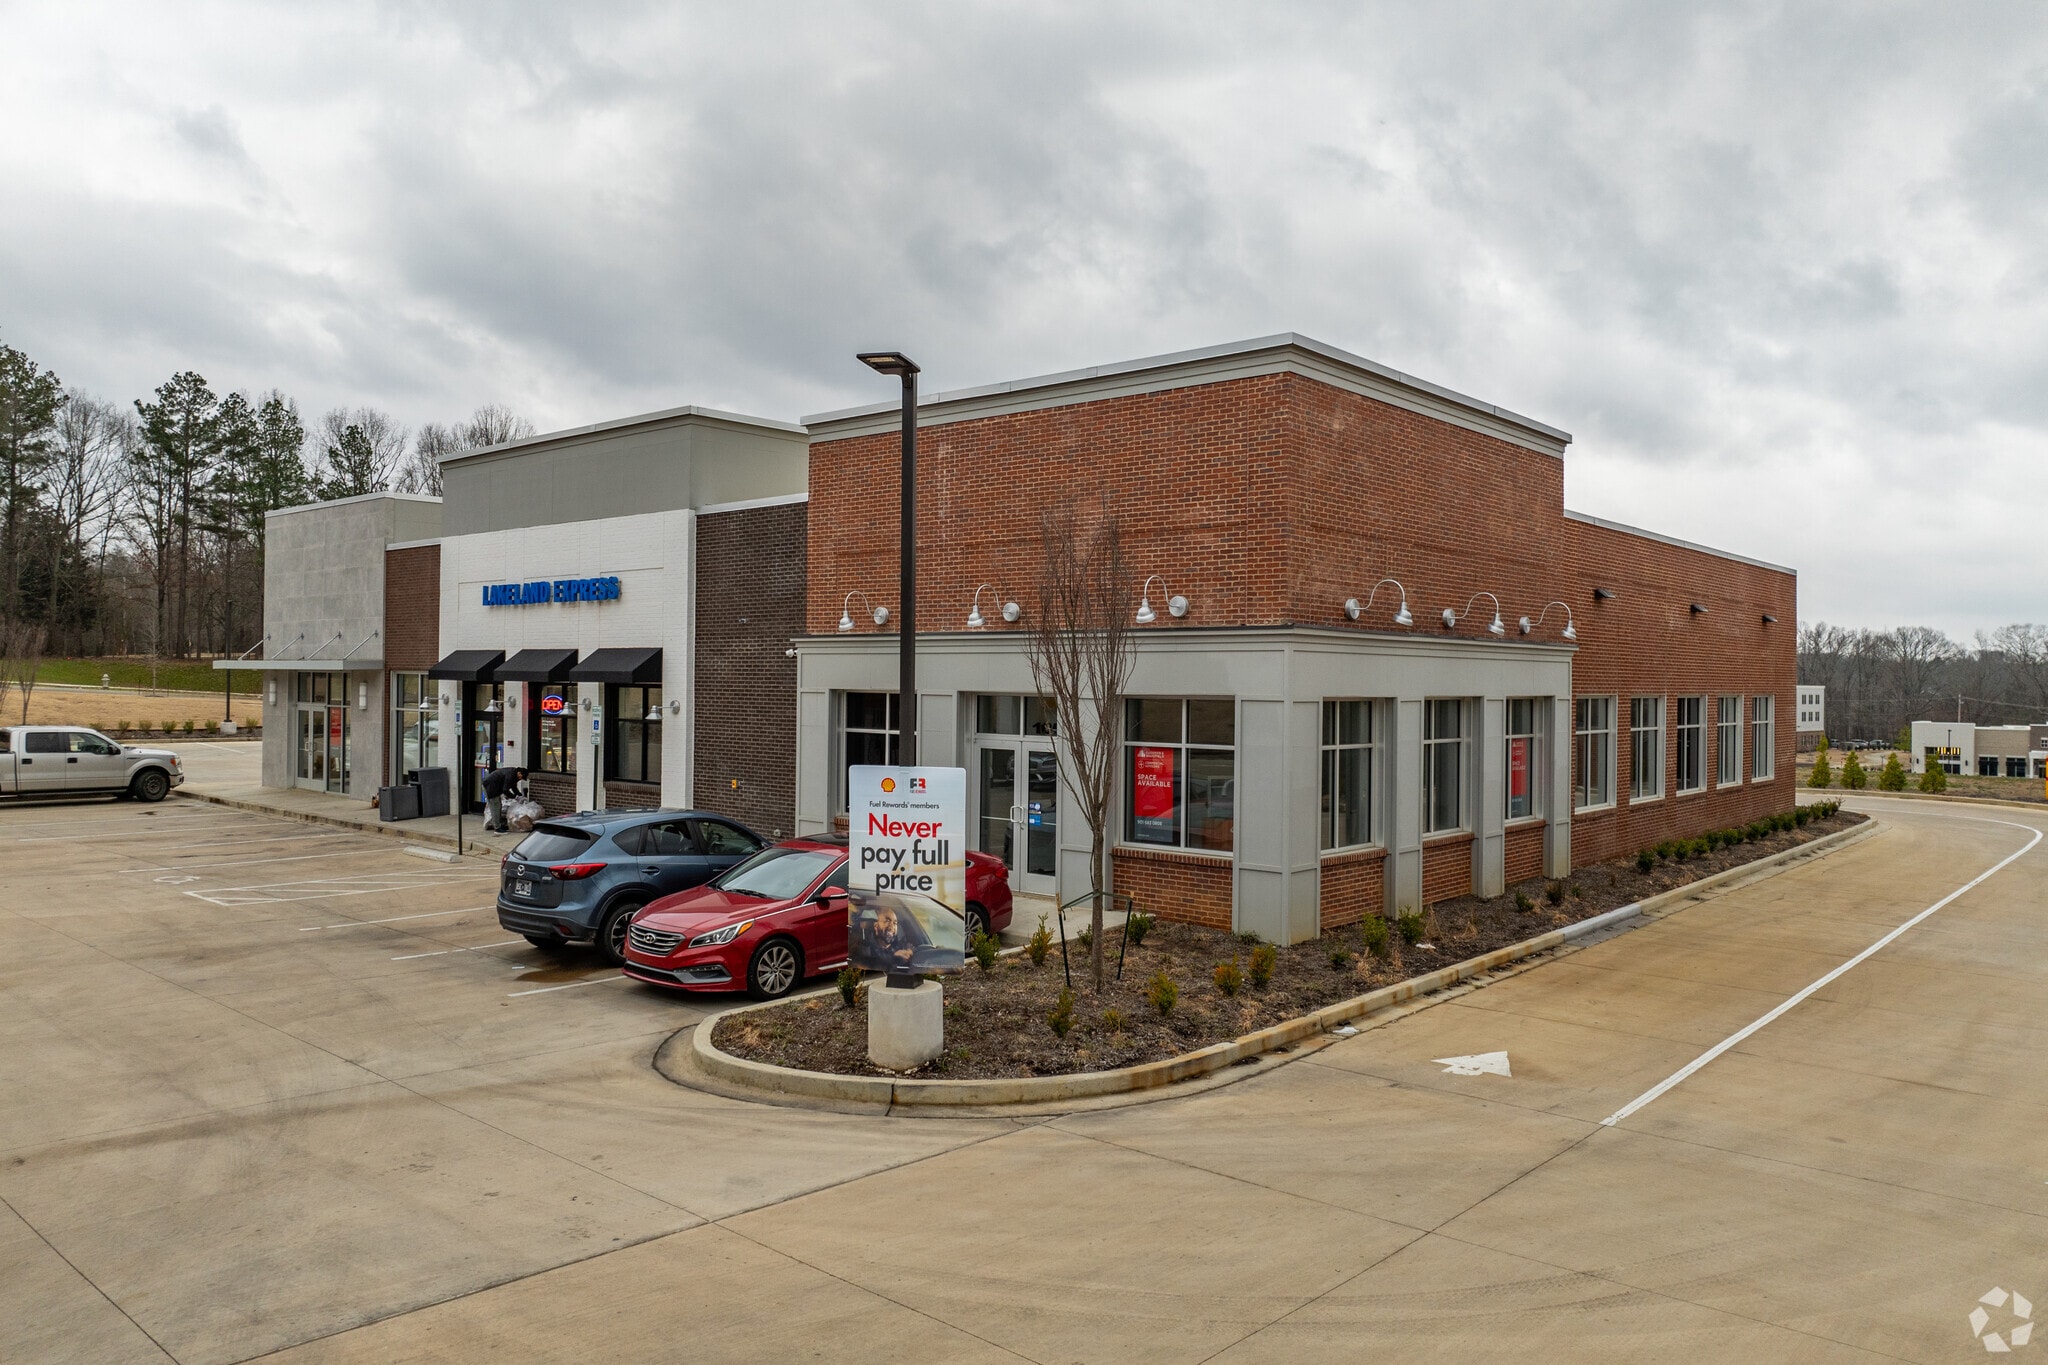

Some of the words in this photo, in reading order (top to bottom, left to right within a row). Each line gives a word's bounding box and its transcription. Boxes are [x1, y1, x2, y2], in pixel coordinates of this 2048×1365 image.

[482, 582, 551, 606] LAKELAND
[553, 576, 618, 603] EXPRESS
[910, 802, 940, 810] members
[868, 812, 942, 838] Never
[861, 846, 907, 871] pay
[912, 838, 949, 865] full
[876, 866, 933, 896] price
